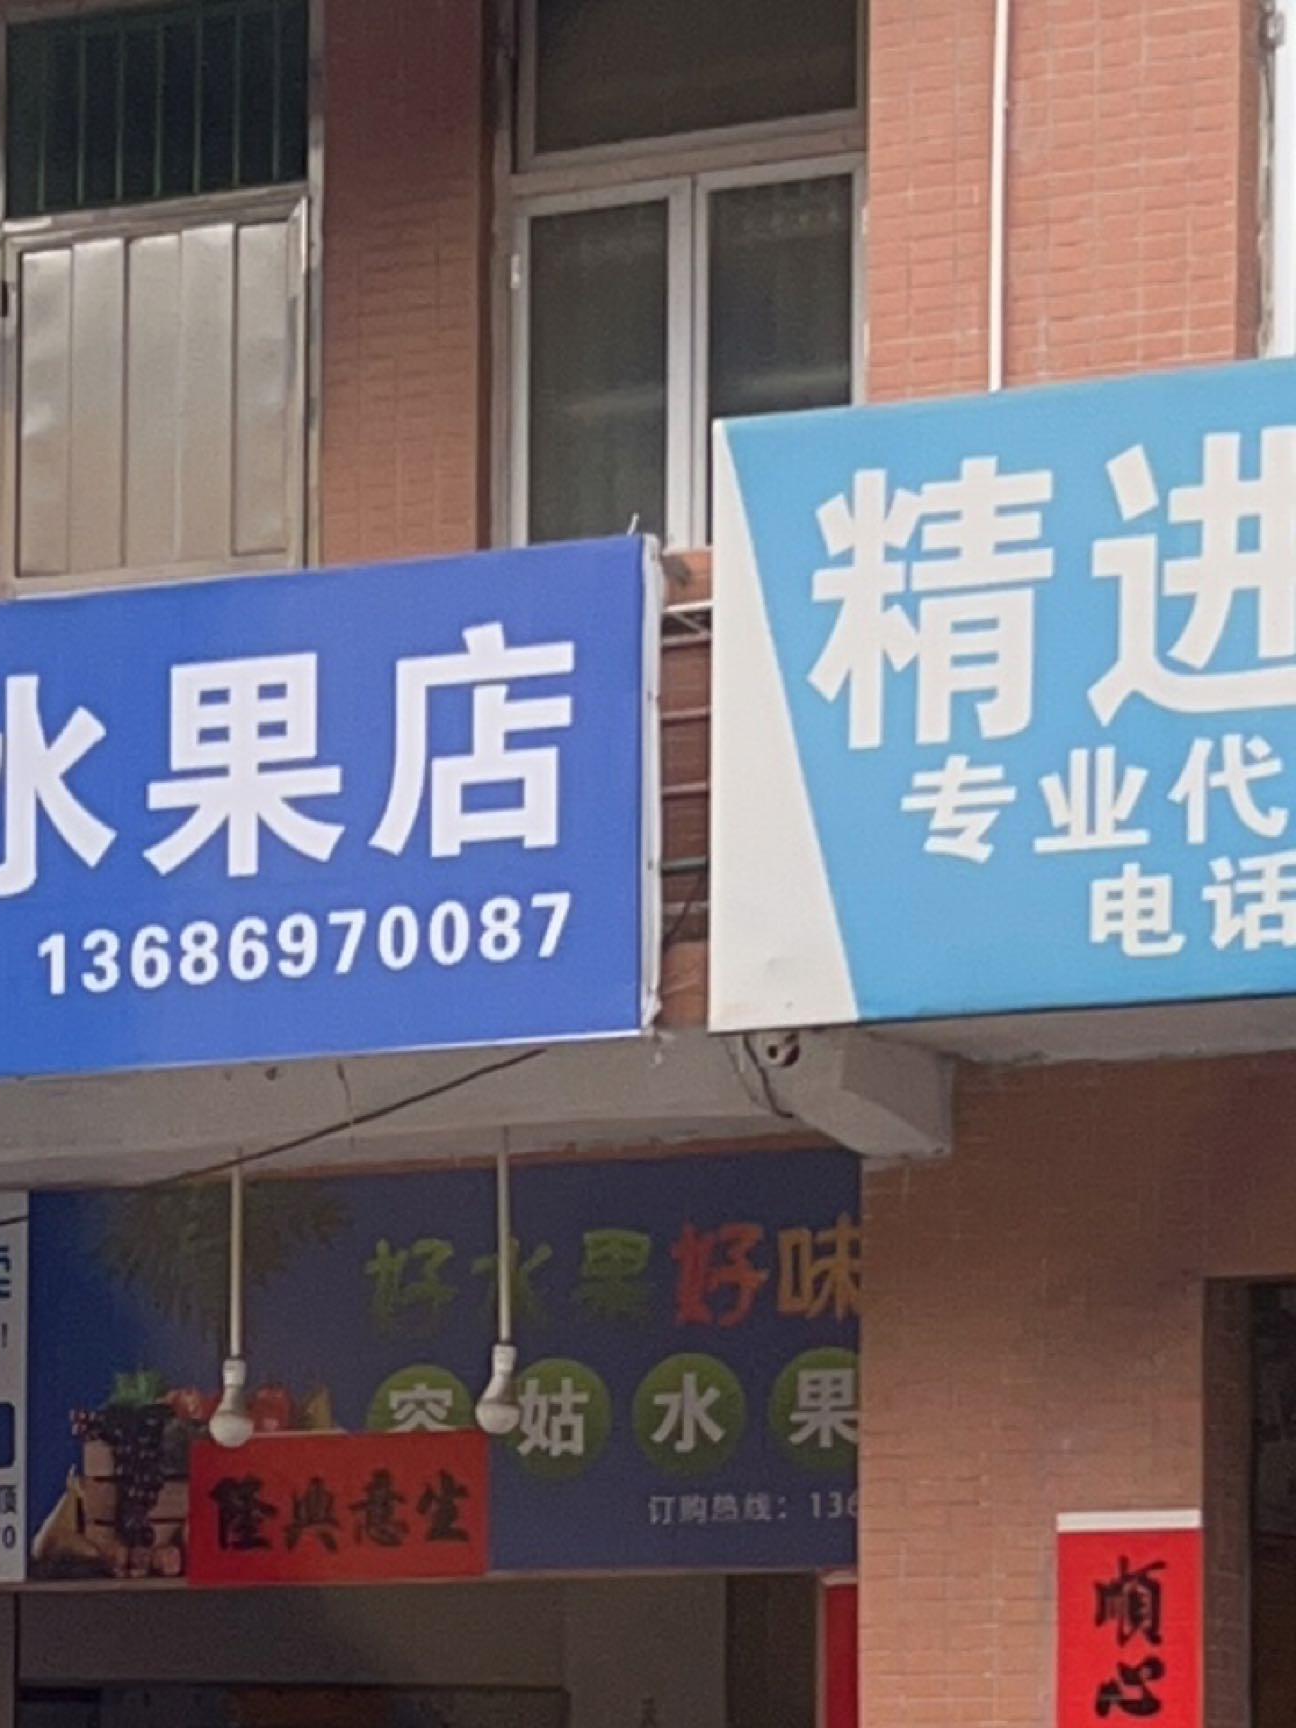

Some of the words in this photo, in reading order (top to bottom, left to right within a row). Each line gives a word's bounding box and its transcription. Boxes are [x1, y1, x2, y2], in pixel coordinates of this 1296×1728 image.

[901, 734, 1288, 863] 专业代
[1089, 851, 1296, 957] 电话
